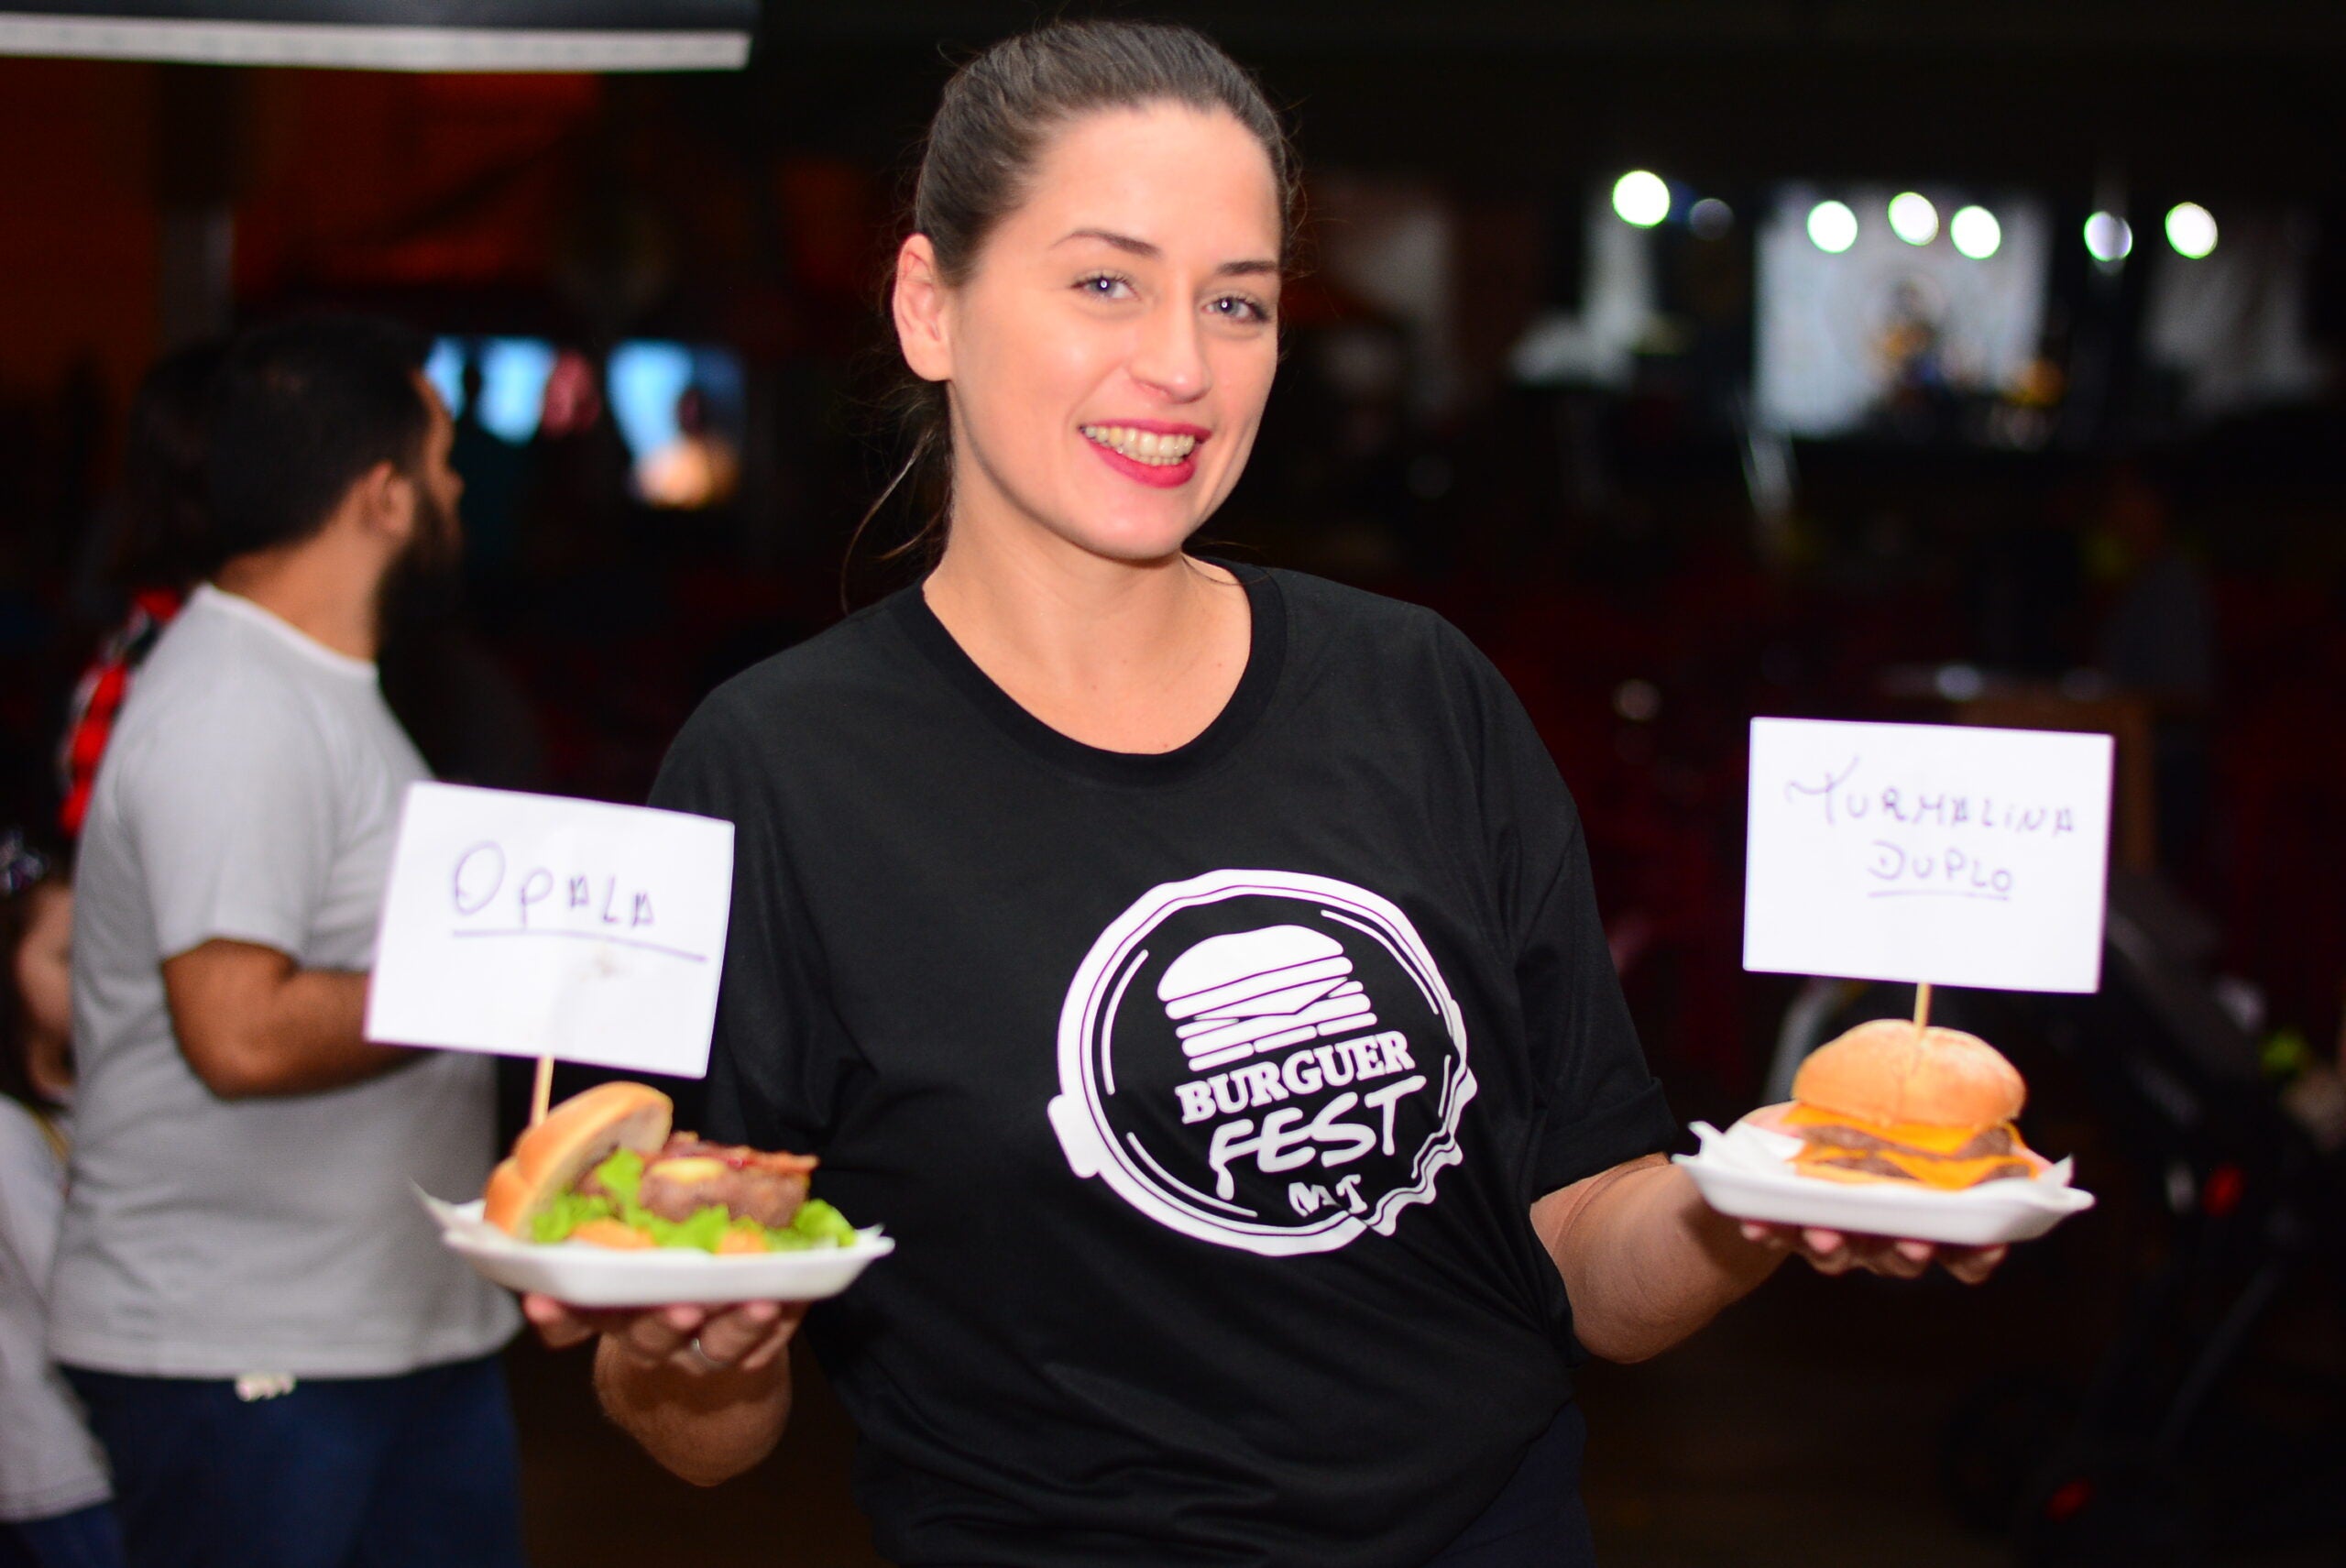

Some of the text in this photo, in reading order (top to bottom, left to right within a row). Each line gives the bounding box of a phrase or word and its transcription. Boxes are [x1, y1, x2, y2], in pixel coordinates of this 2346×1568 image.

[1867, 839, 2013, 893] DUPLO
[1175, 1030, 1416, 1124] BURGUER
[1209, 1075, 1427, 1201] FEST
[1288, 1174, 1368, 1217] MT
